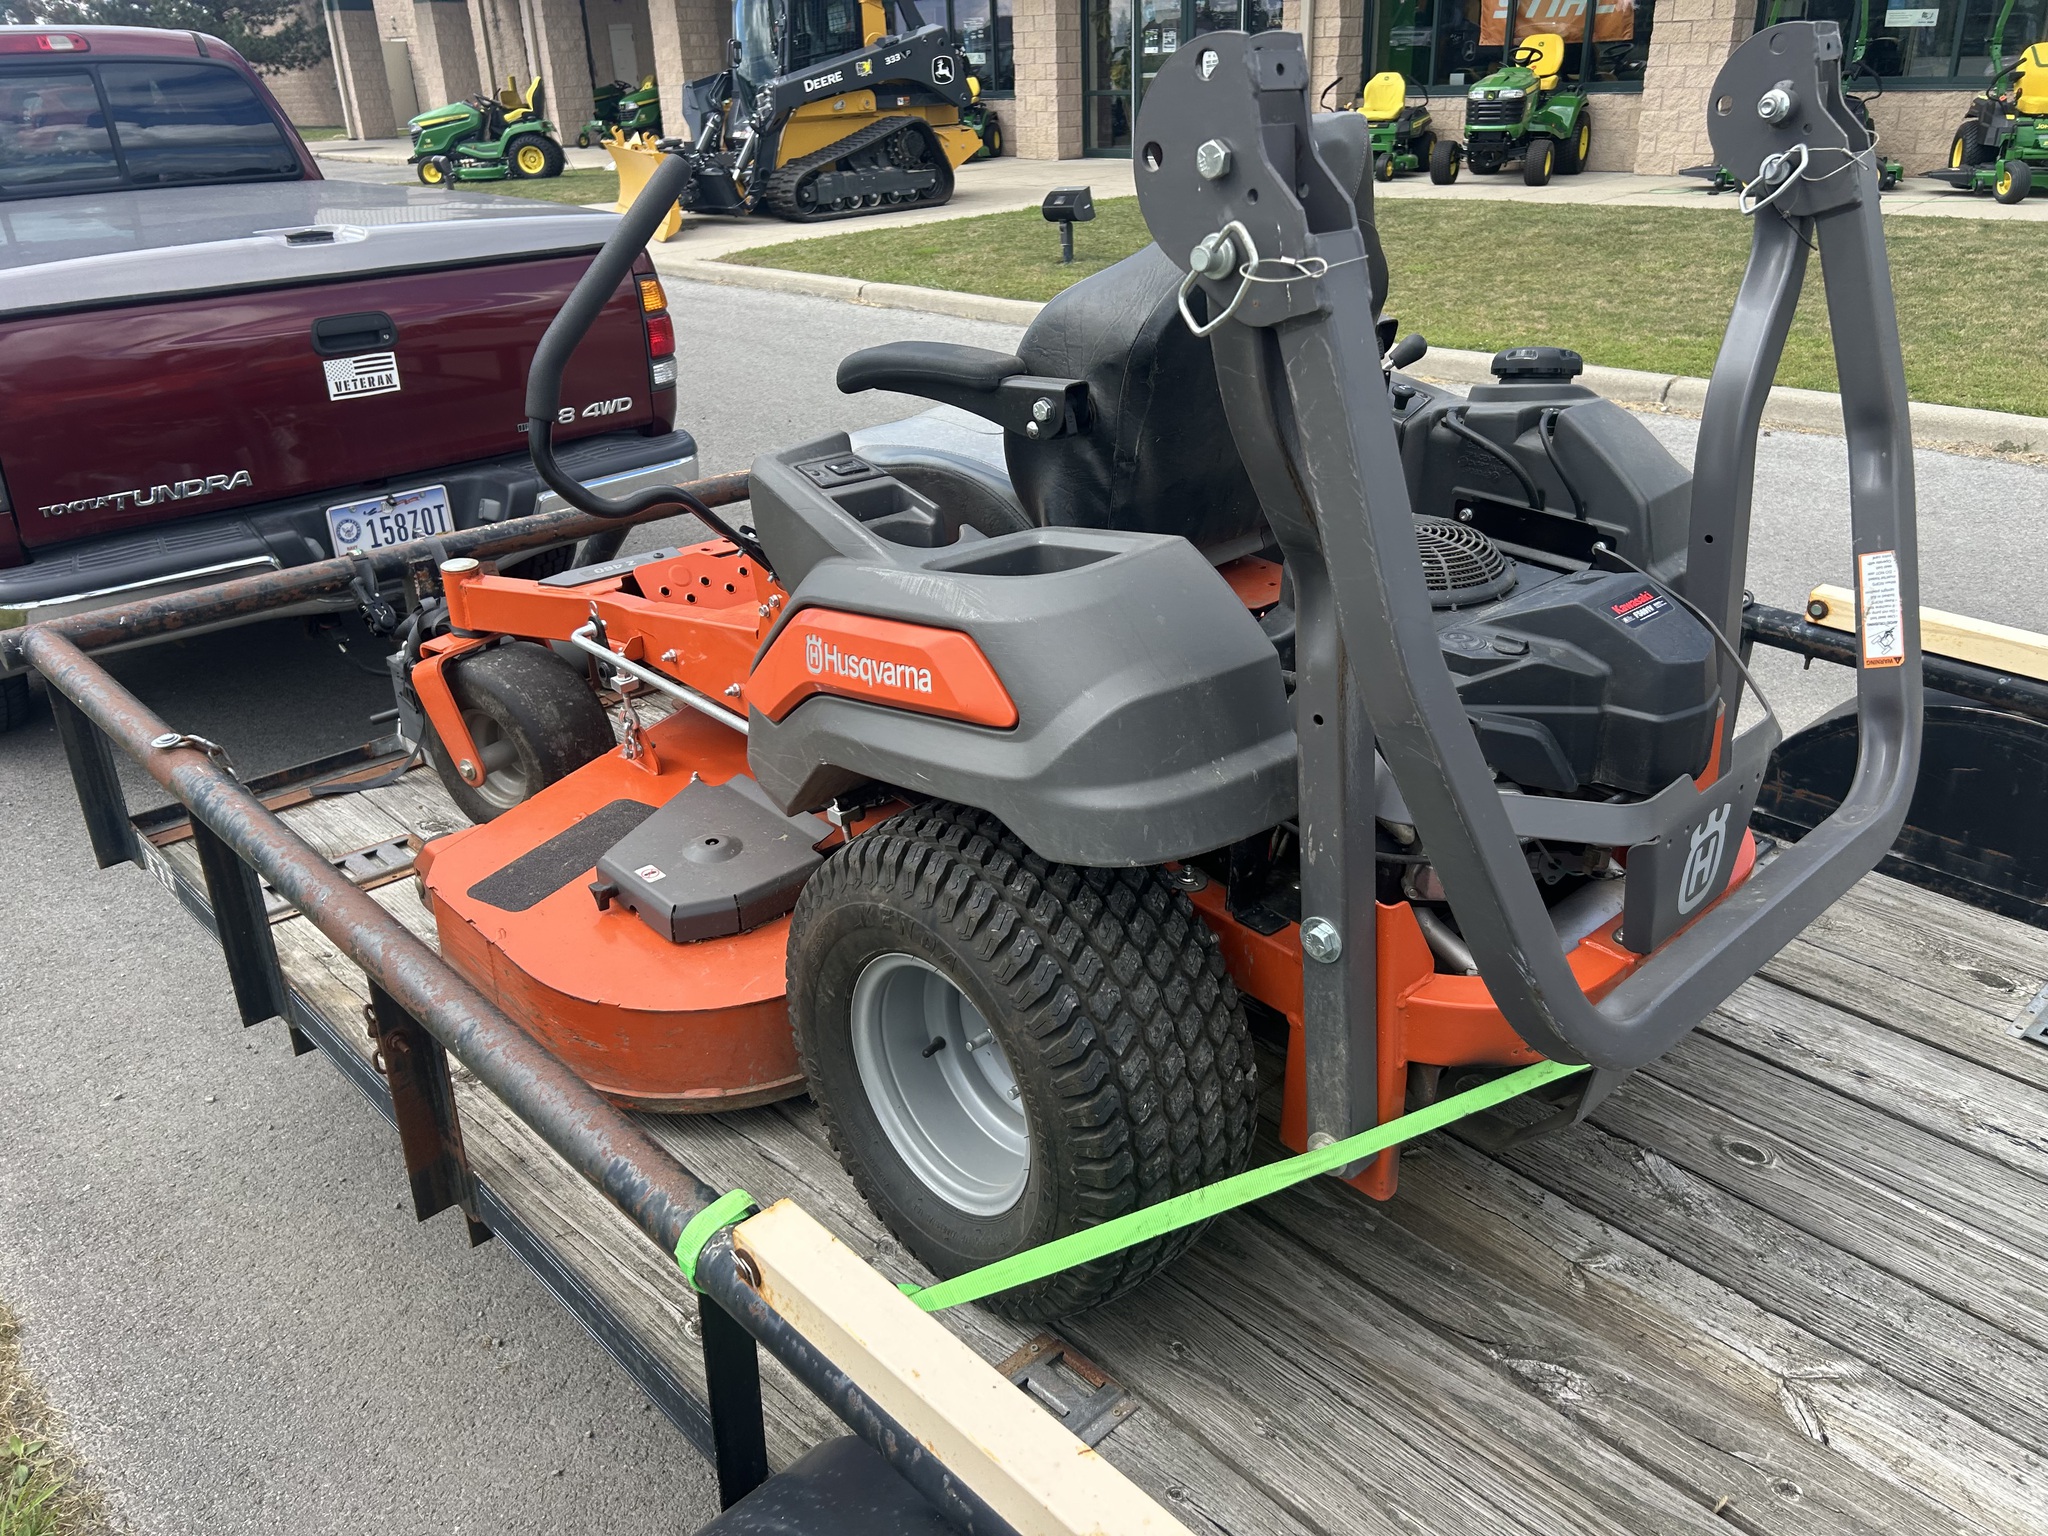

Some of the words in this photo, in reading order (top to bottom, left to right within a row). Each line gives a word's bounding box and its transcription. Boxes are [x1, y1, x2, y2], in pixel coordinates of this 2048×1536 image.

[804, 71, 844, 92] DEERE
[334, 374, 393, 392] VETERAN
[582, 396, 632, 418] 4WD
[38, 496, 110, 518] TOYOTA
[108, 470, 254, 512] TUNDRA
[1611, 590, 1654, 615] Kawasaki
[824, 643, 932, 694] Husqvarna
[1866, 658, 1893, 666] WARNING
